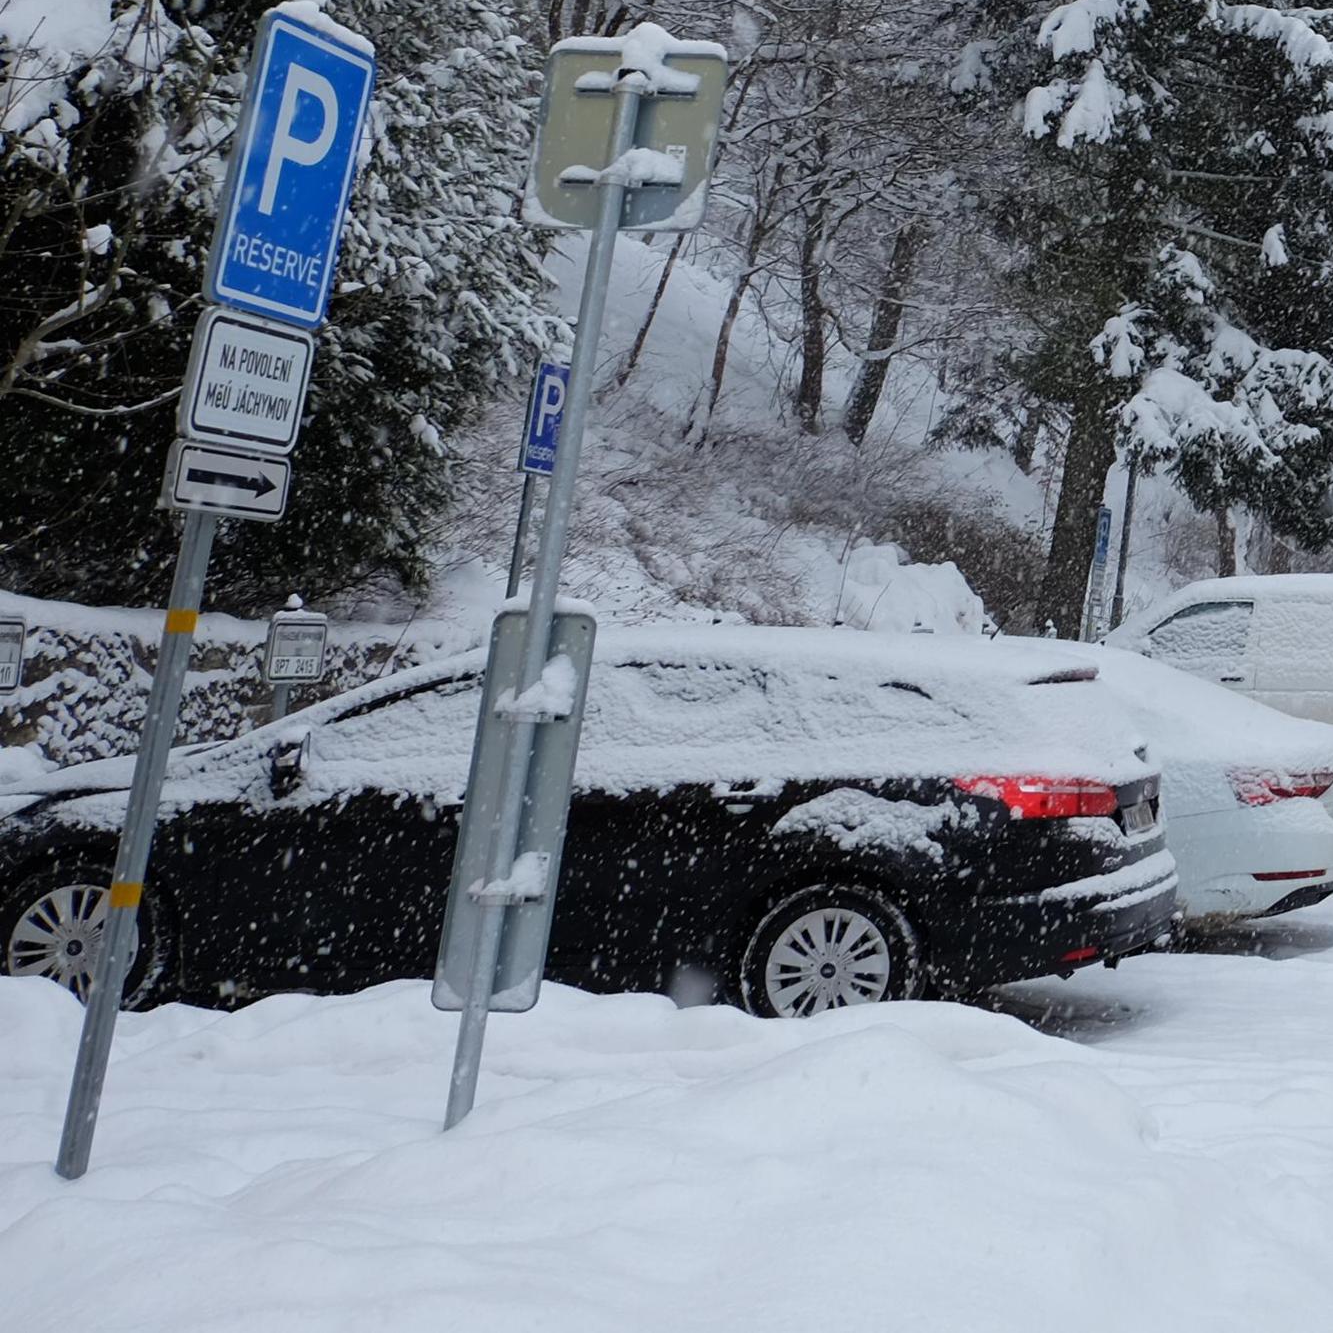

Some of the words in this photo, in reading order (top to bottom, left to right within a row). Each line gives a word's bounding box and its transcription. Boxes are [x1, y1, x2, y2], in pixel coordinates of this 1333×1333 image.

[258, 62, 339, 216] P
[233, 233, 322, 287] RÉSERVÉ
[220, 343, 237, 371] NA
[238, 348, 295, 383] POVOLENÍ
[232, 384, 292, 422] JÁCHYMOV
[536, 374, 566, 437] P
